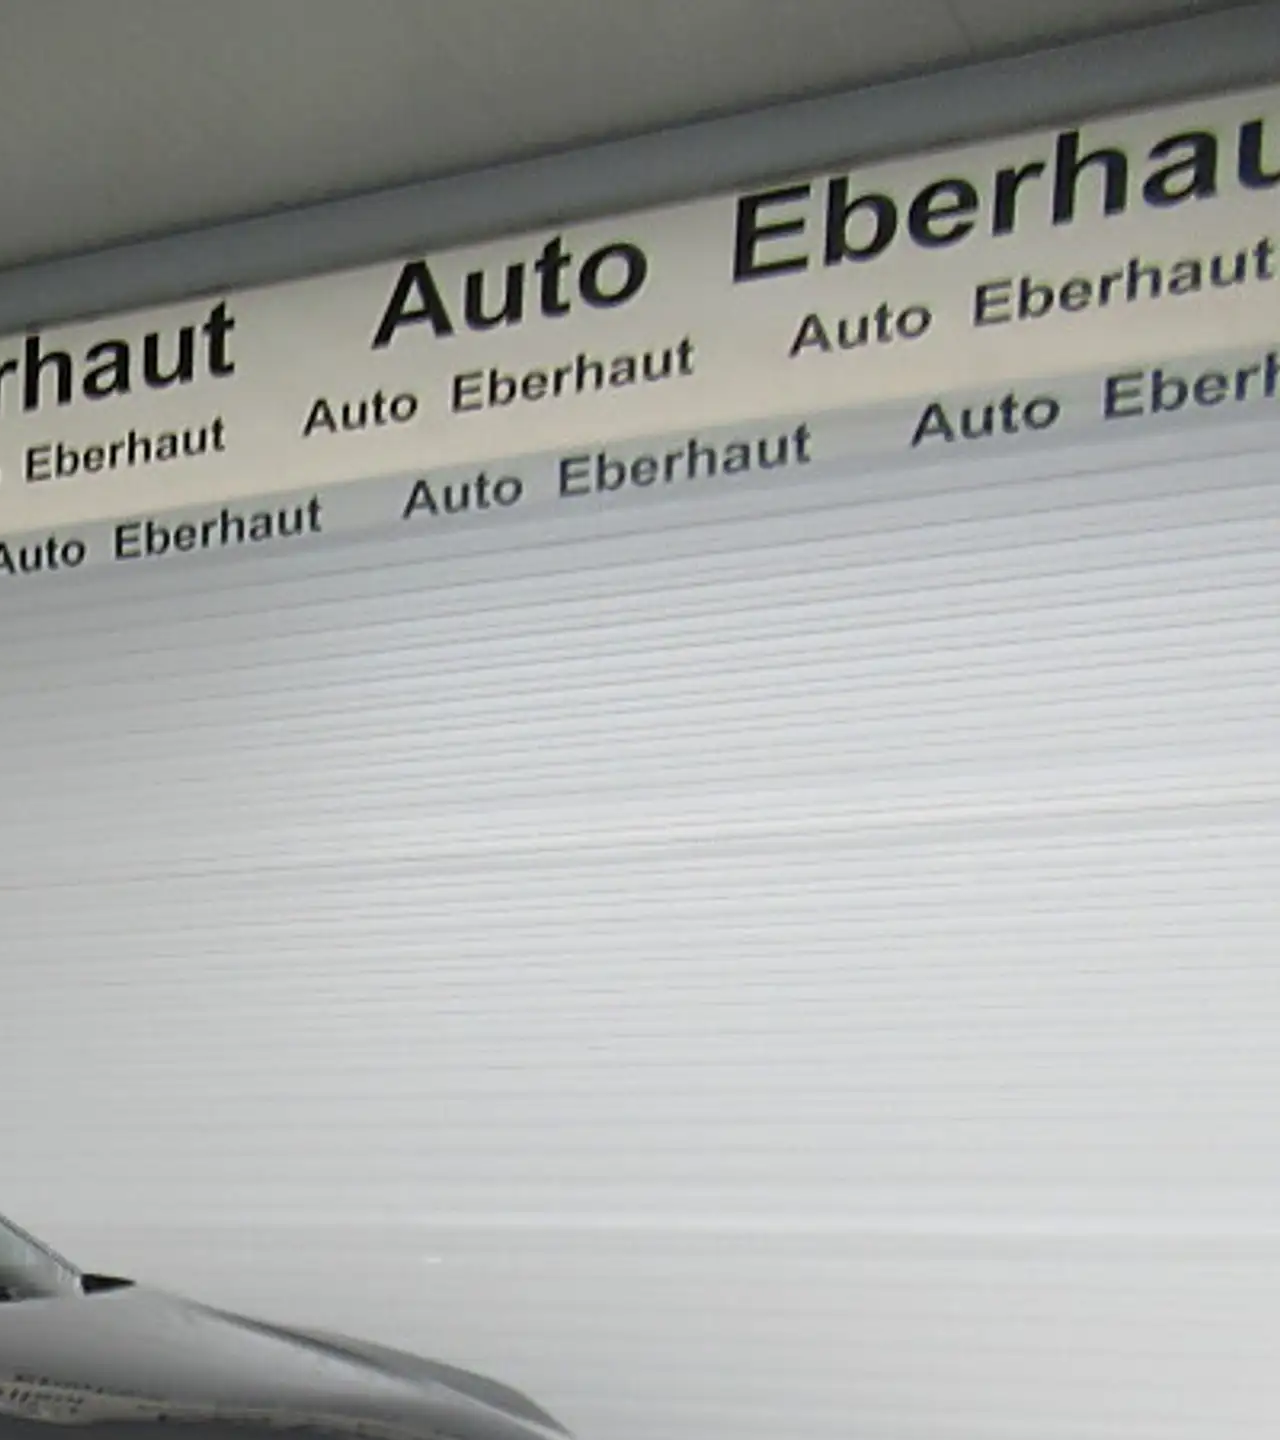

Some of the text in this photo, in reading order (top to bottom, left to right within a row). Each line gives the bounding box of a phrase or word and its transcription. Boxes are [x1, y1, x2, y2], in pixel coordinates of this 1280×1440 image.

[371, 236, 648, 351] Auto
[789, 237, 1276, 358] Auto Eberhaut
[303, 336, 695, 438] Auto Eberhaut
[910, 391, 1062, 449] Auto
[25, 416, 226, 483] Eberhaut
[402, 421, 812, 521] Auto Eberhaut
[114, 494, 322, 561] Eberhaut
